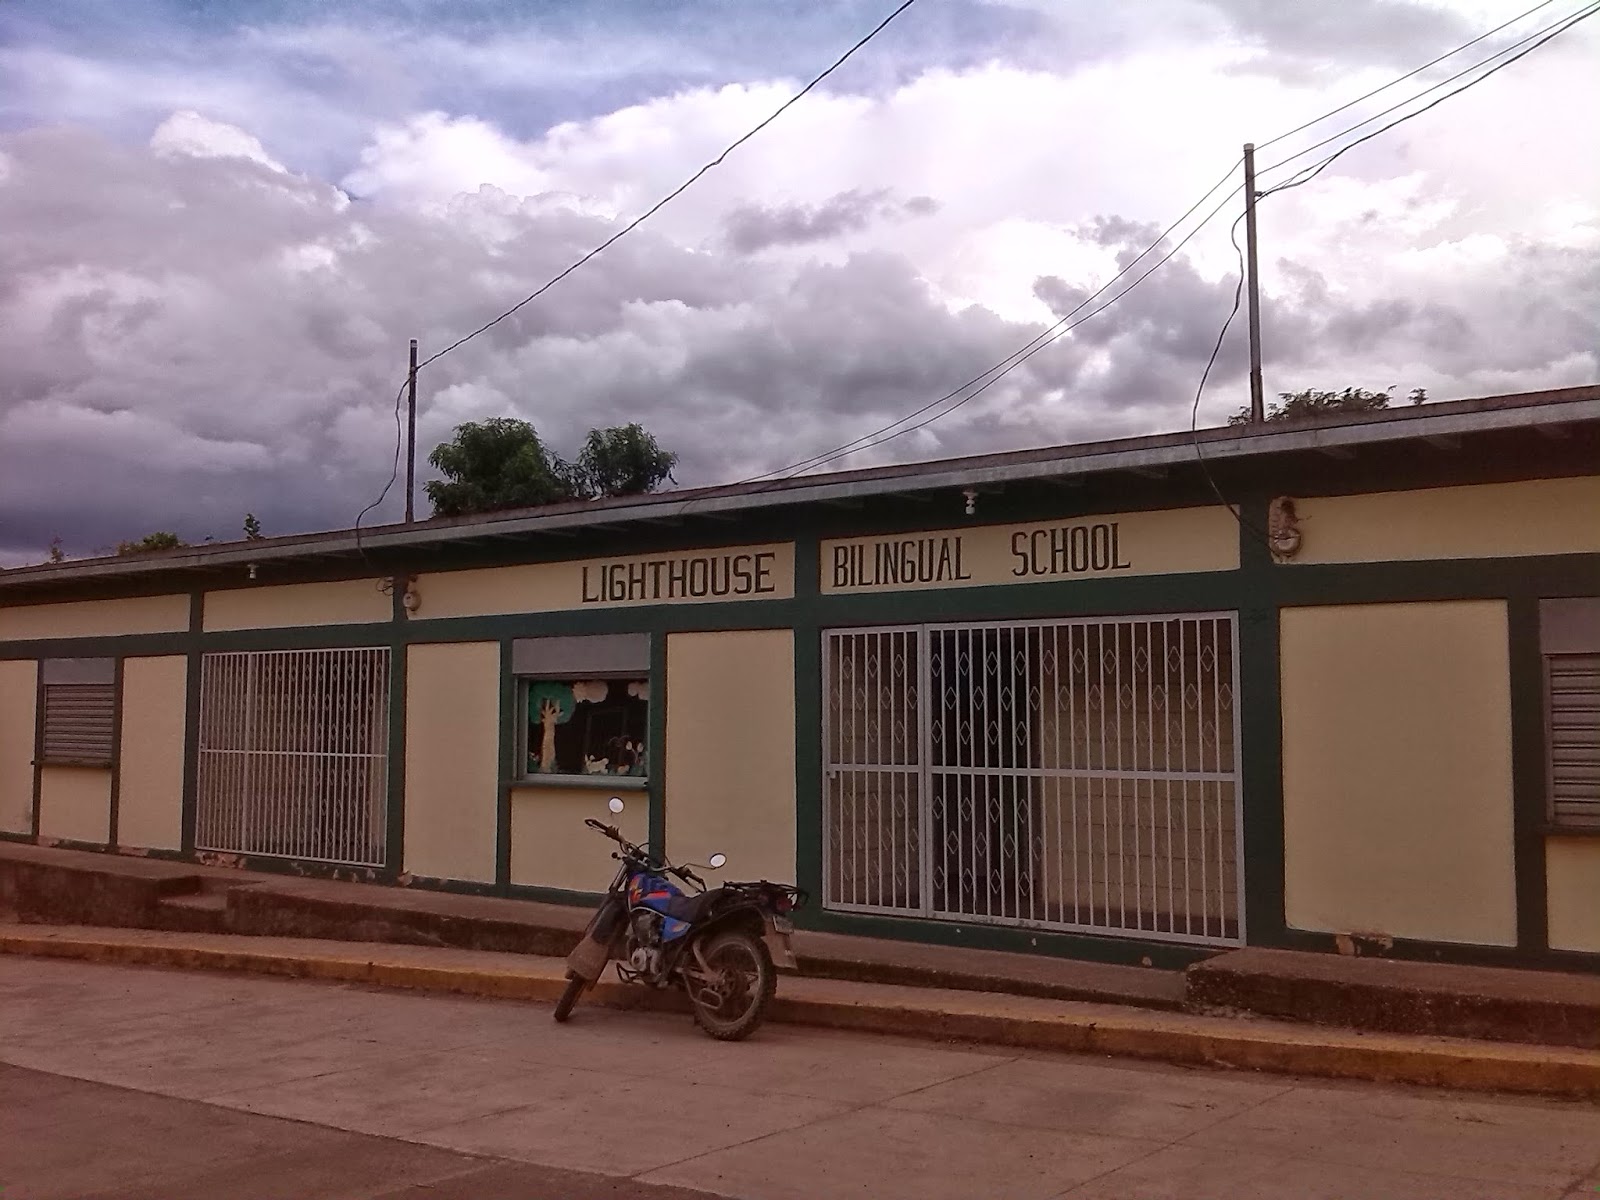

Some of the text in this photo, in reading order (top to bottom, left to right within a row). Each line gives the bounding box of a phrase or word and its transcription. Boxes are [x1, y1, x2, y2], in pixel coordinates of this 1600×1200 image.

[582, 522, 1132, 603] LIGHTHOUSE BILINGUAL SCHOOL
